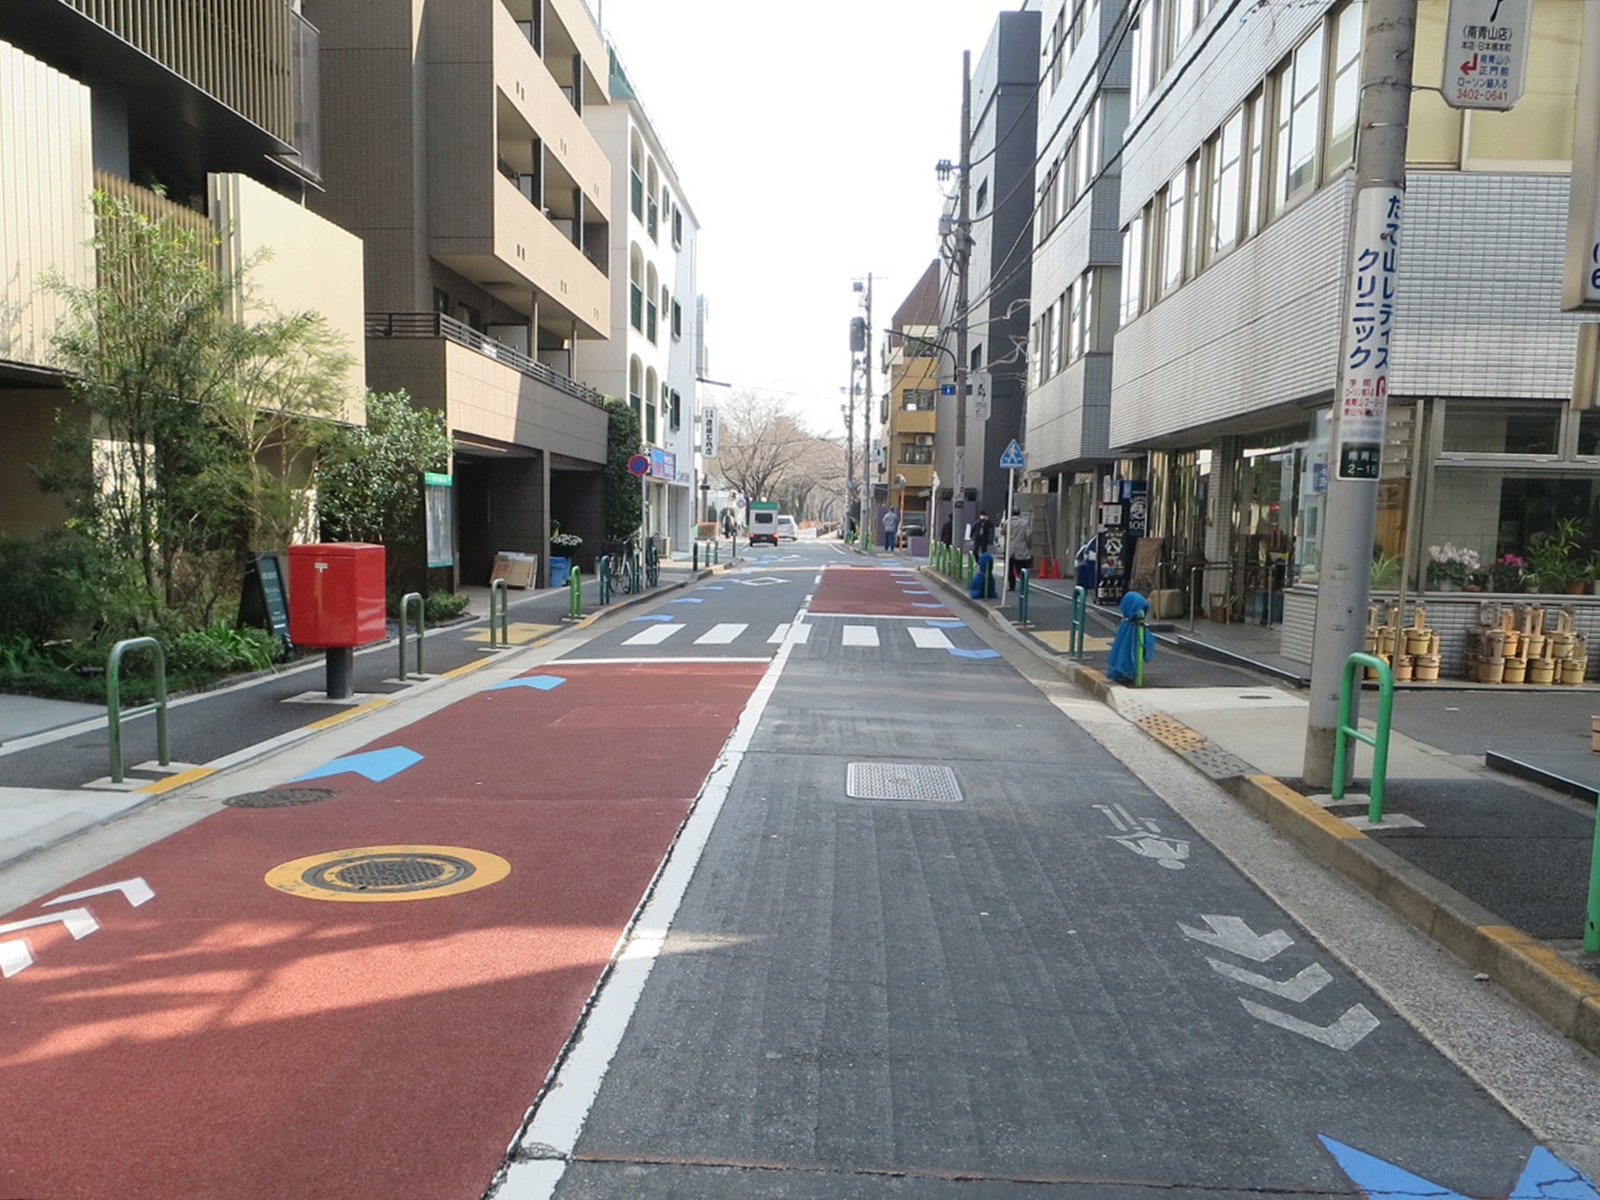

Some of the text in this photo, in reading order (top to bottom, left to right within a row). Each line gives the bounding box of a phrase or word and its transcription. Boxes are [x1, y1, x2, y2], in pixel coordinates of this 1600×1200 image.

[1456, 88, 1508, 101] 3402-0641
[1350, 248, 1380, 370] クリニック
